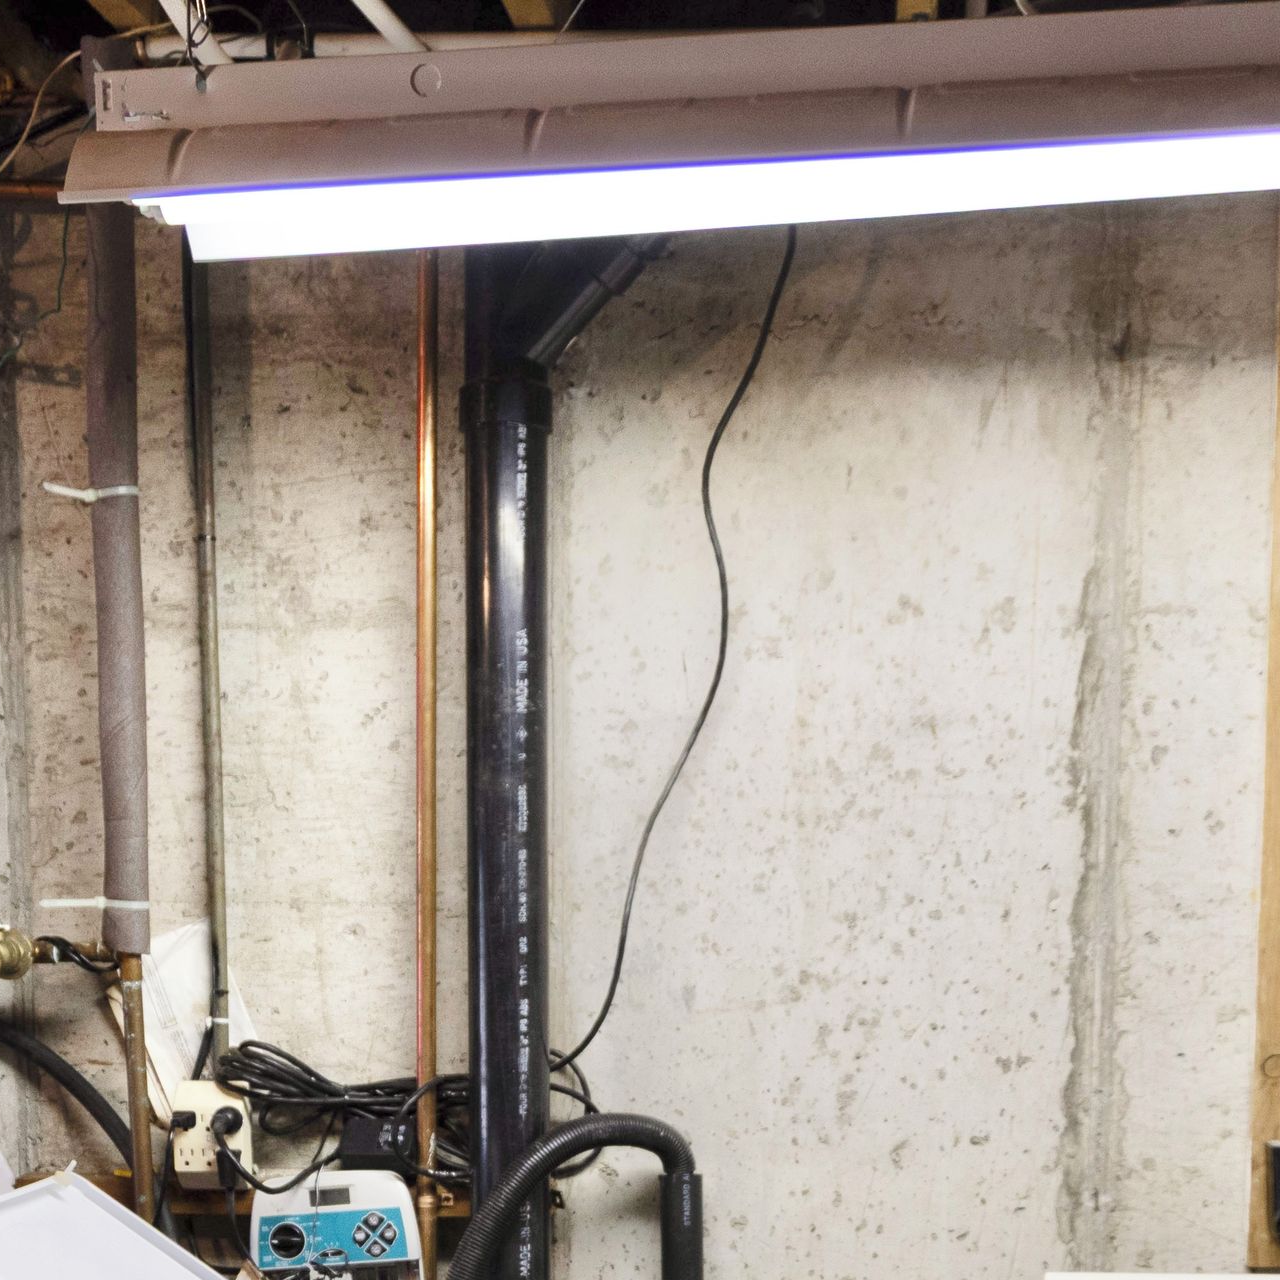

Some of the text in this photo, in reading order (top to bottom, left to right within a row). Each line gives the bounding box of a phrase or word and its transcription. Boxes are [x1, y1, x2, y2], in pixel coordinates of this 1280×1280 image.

[516, 628, 528, 714] MADE IN USA
[682, 1183, 691, 1226] STANDARD
[520, 1243, 531, 1277] MADE
